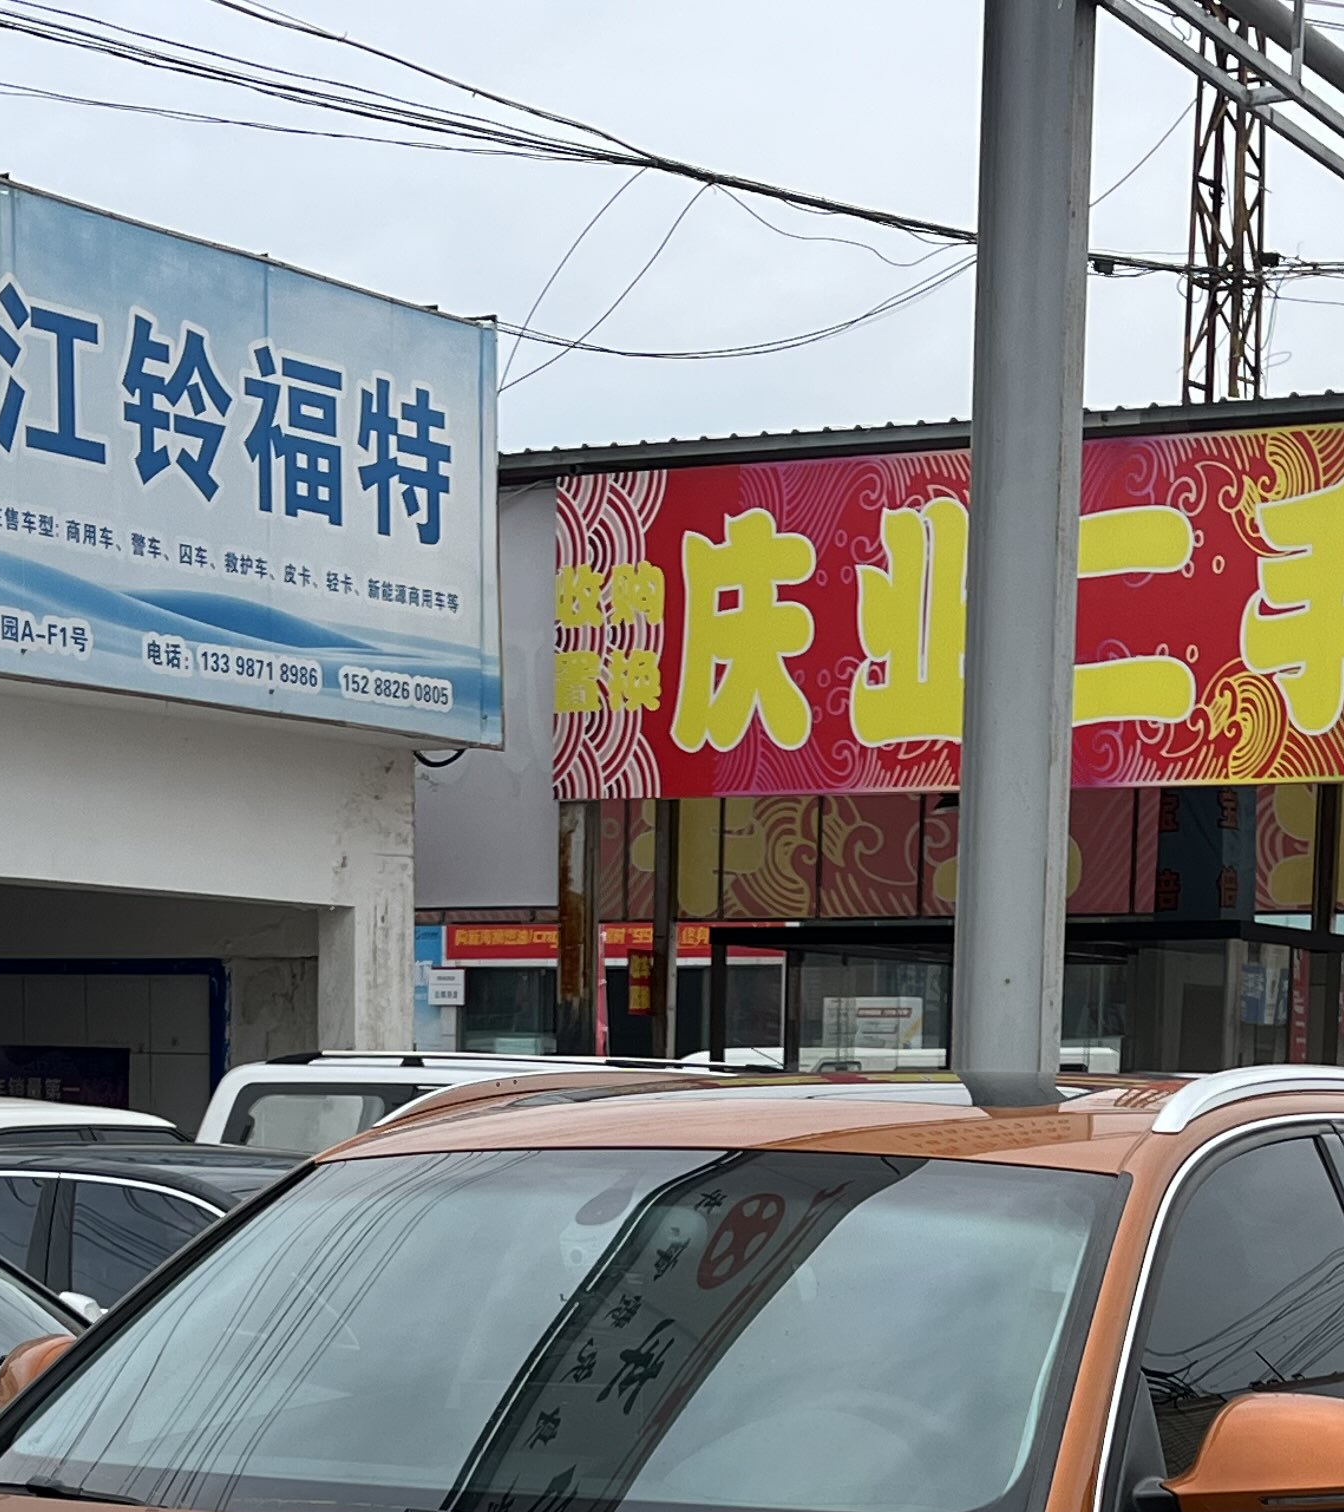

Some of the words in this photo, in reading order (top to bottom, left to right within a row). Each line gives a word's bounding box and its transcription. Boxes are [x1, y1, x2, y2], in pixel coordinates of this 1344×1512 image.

[200, 651, 231, 675] 133
[235, 657, 274, 681] 9871
[279, 662, 319, 687] 8986
[342, 672, 370, 695] 152
[374, 676, 411, 700] 8826
[414, 682, 449, 706] 0805
